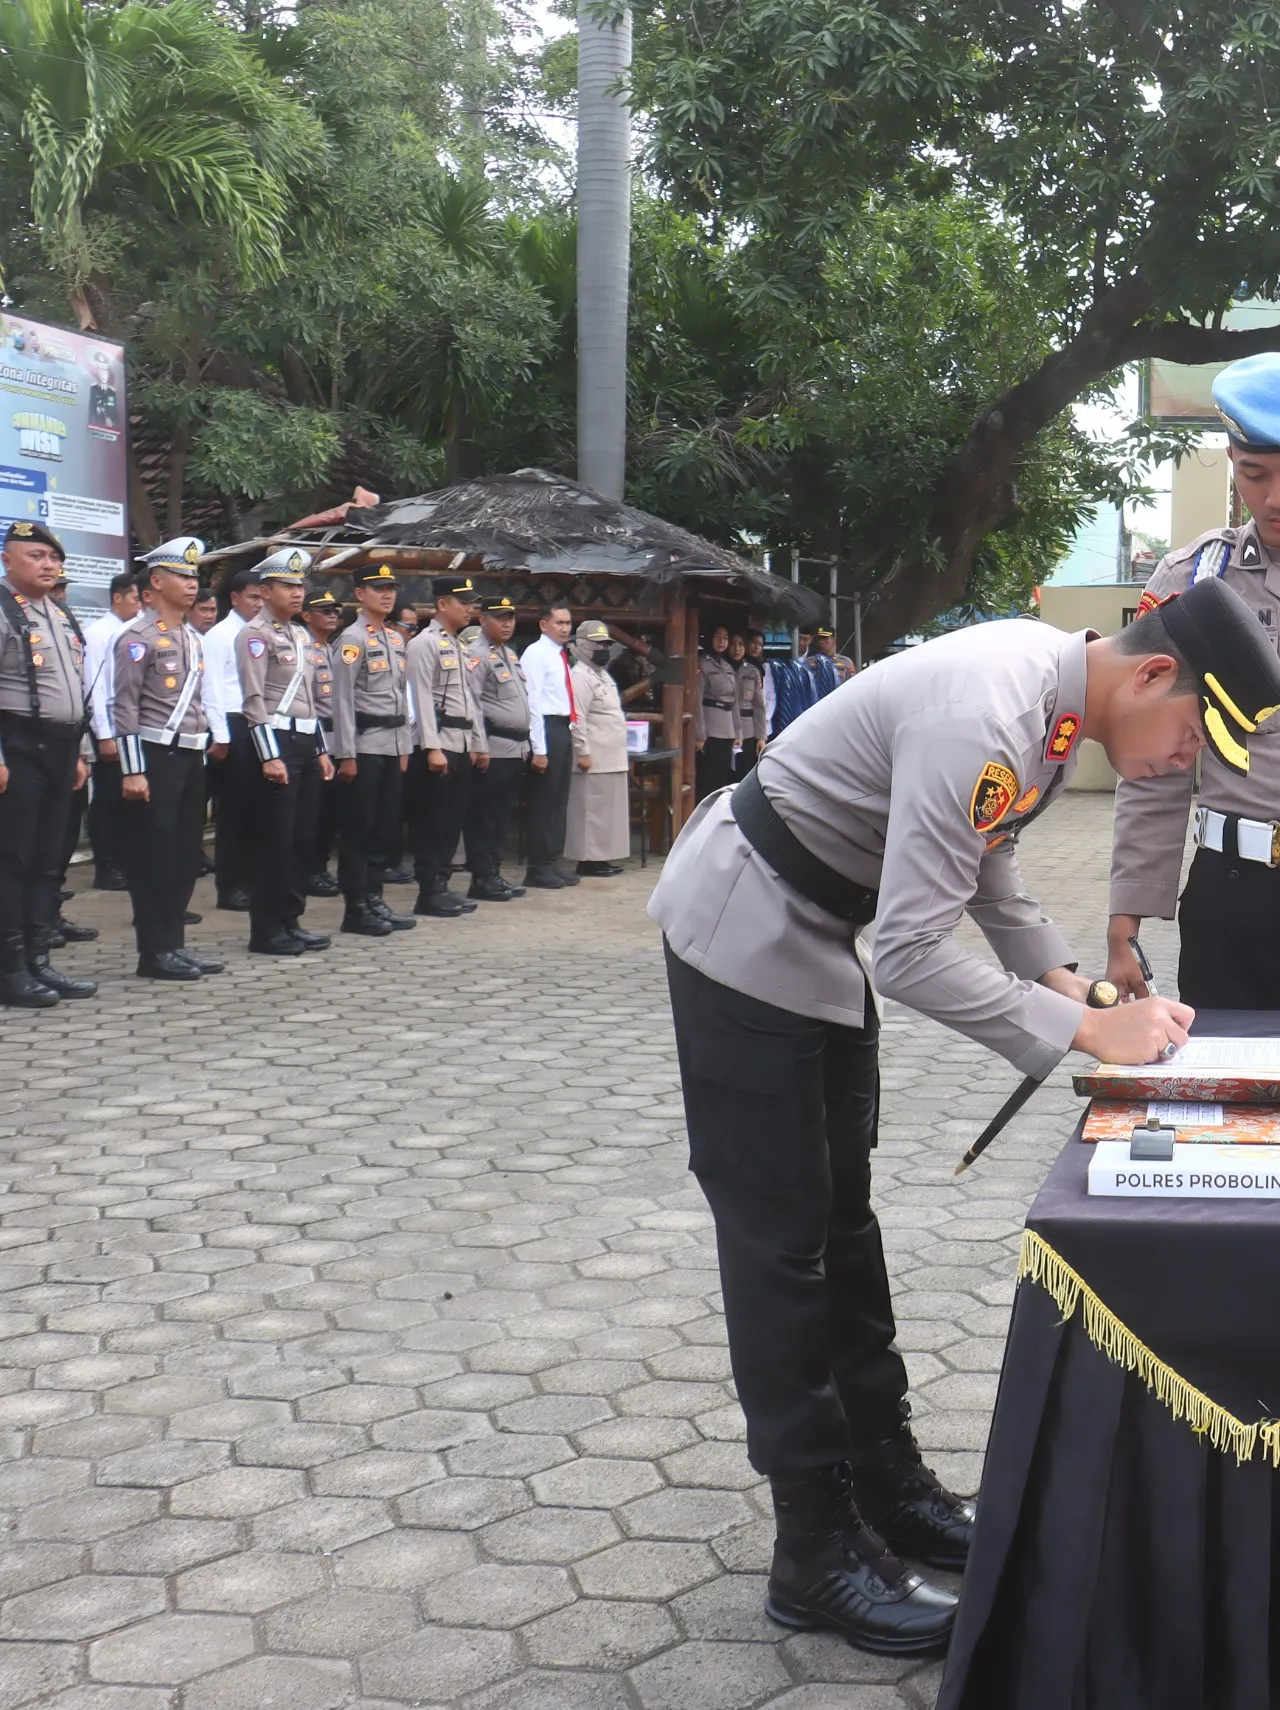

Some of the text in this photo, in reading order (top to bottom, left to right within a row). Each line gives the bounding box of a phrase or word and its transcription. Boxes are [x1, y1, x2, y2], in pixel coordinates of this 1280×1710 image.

[26, 369, 76, 392] Integritas
[41, 502, 48, 515] 2
[1115, 1173, 1183, 1188] POLRES
